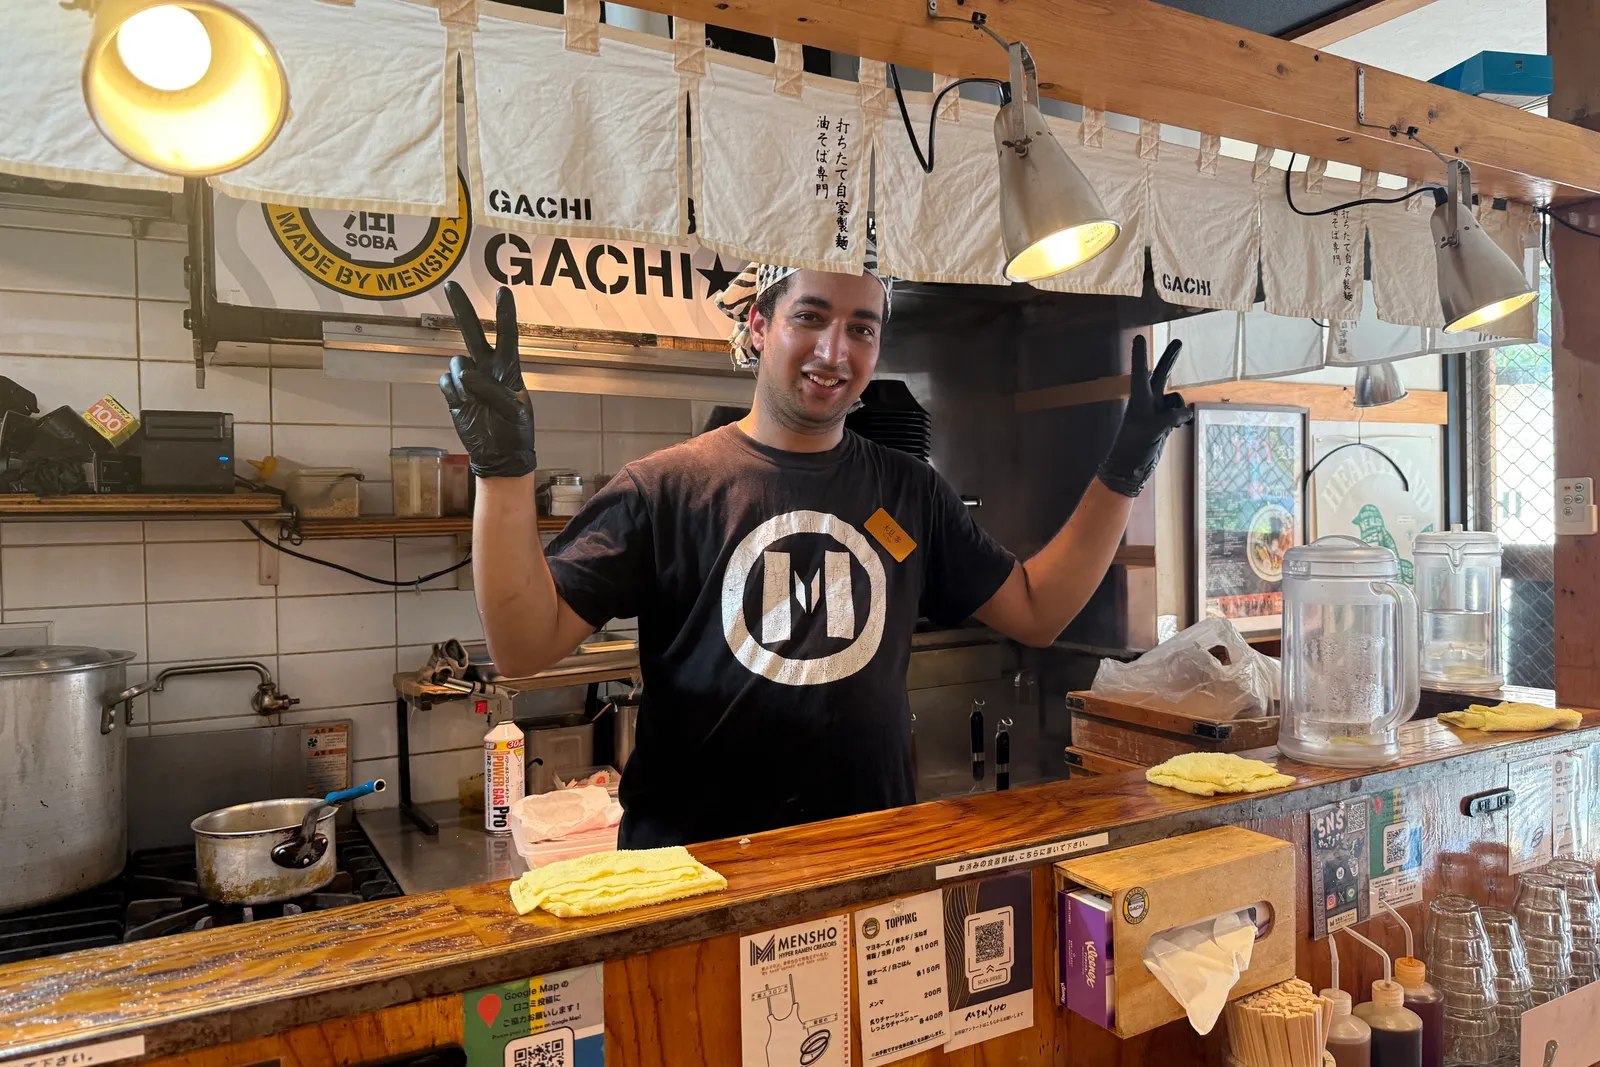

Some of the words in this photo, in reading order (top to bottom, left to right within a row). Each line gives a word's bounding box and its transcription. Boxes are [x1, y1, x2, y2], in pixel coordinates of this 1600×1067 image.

[816, 116, 830, 199] 油そば専門
[835, 118, 850, 250] 打ちたて自家製麺
[489, 189, 592, 220] GACHI
[276, 211, 335, 276] MADE
[336, 265, 371, 290] BY
[376, 229, 460, 291] MENSHO
[346, 234, 398, 250] SOBA
[484, 232, 694, 300] GACHI
[1162, 274, 1212, 297] GACHI
[91, 404, 122, 432] 100
[492, 756, 505, 786] POWER
[492, 788, 505, 806] GAS
[493, 806, 510, 828] Pro
[1316, 808, 1345, 838] SNS
[885, 912, 918, 930] TOPPING
[778, 926, 838, 951] MENSHO
[778, 950, 795, 959] HYPER
[795, 946, 812, 956] RAMEN
[814, 940, 837, 951] CREATORS
[1084, 940, 1098, 988] Kleenex
[504, 987, 537, 1001] Google
[540, 982, 560, 994] Map
[561, 980, 569, 988] の
[924, 987, 942, 999] 200円
[869, 1000, 884, 1008] メンマ
[964, 1002, 1007, 1022] MENSHO
